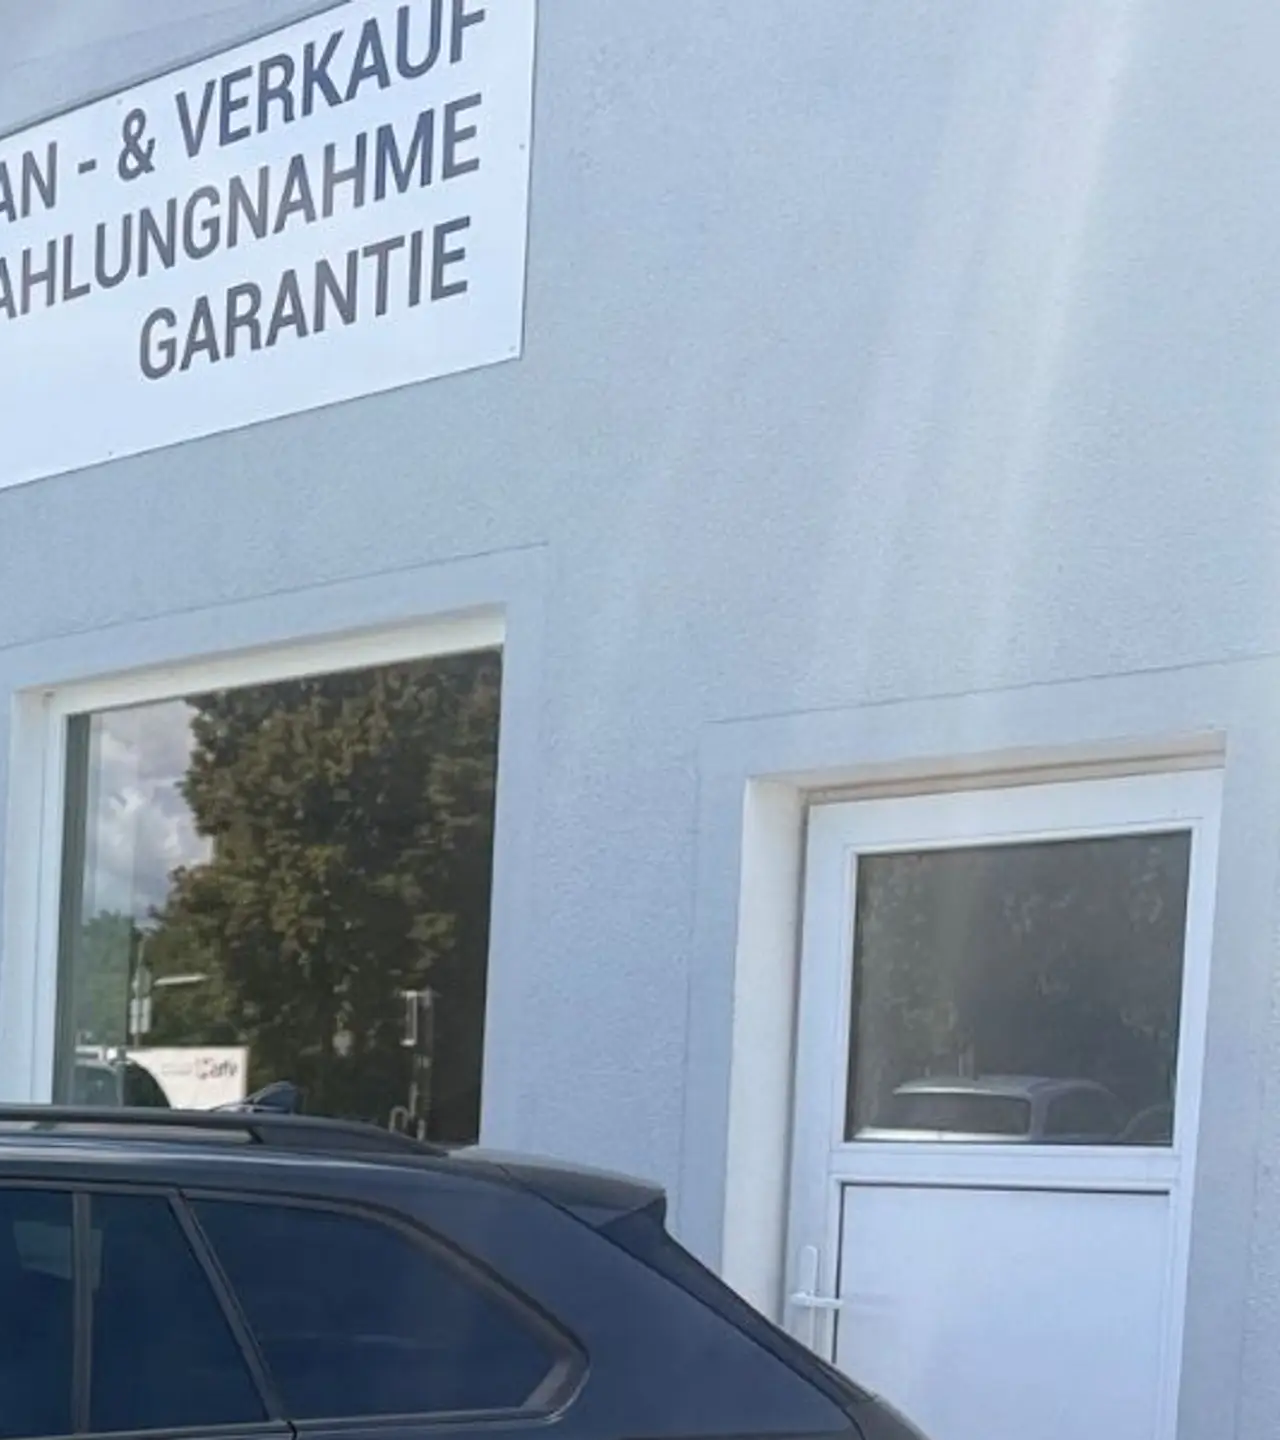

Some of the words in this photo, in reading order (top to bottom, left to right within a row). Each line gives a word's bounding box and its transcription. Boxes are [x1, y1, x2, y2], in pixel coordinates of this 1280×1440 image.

[119, 107, 157, 181] &
[176, 0, 486, 158] VERKAUF
[139, 216, 471, 382] GARANTIE
